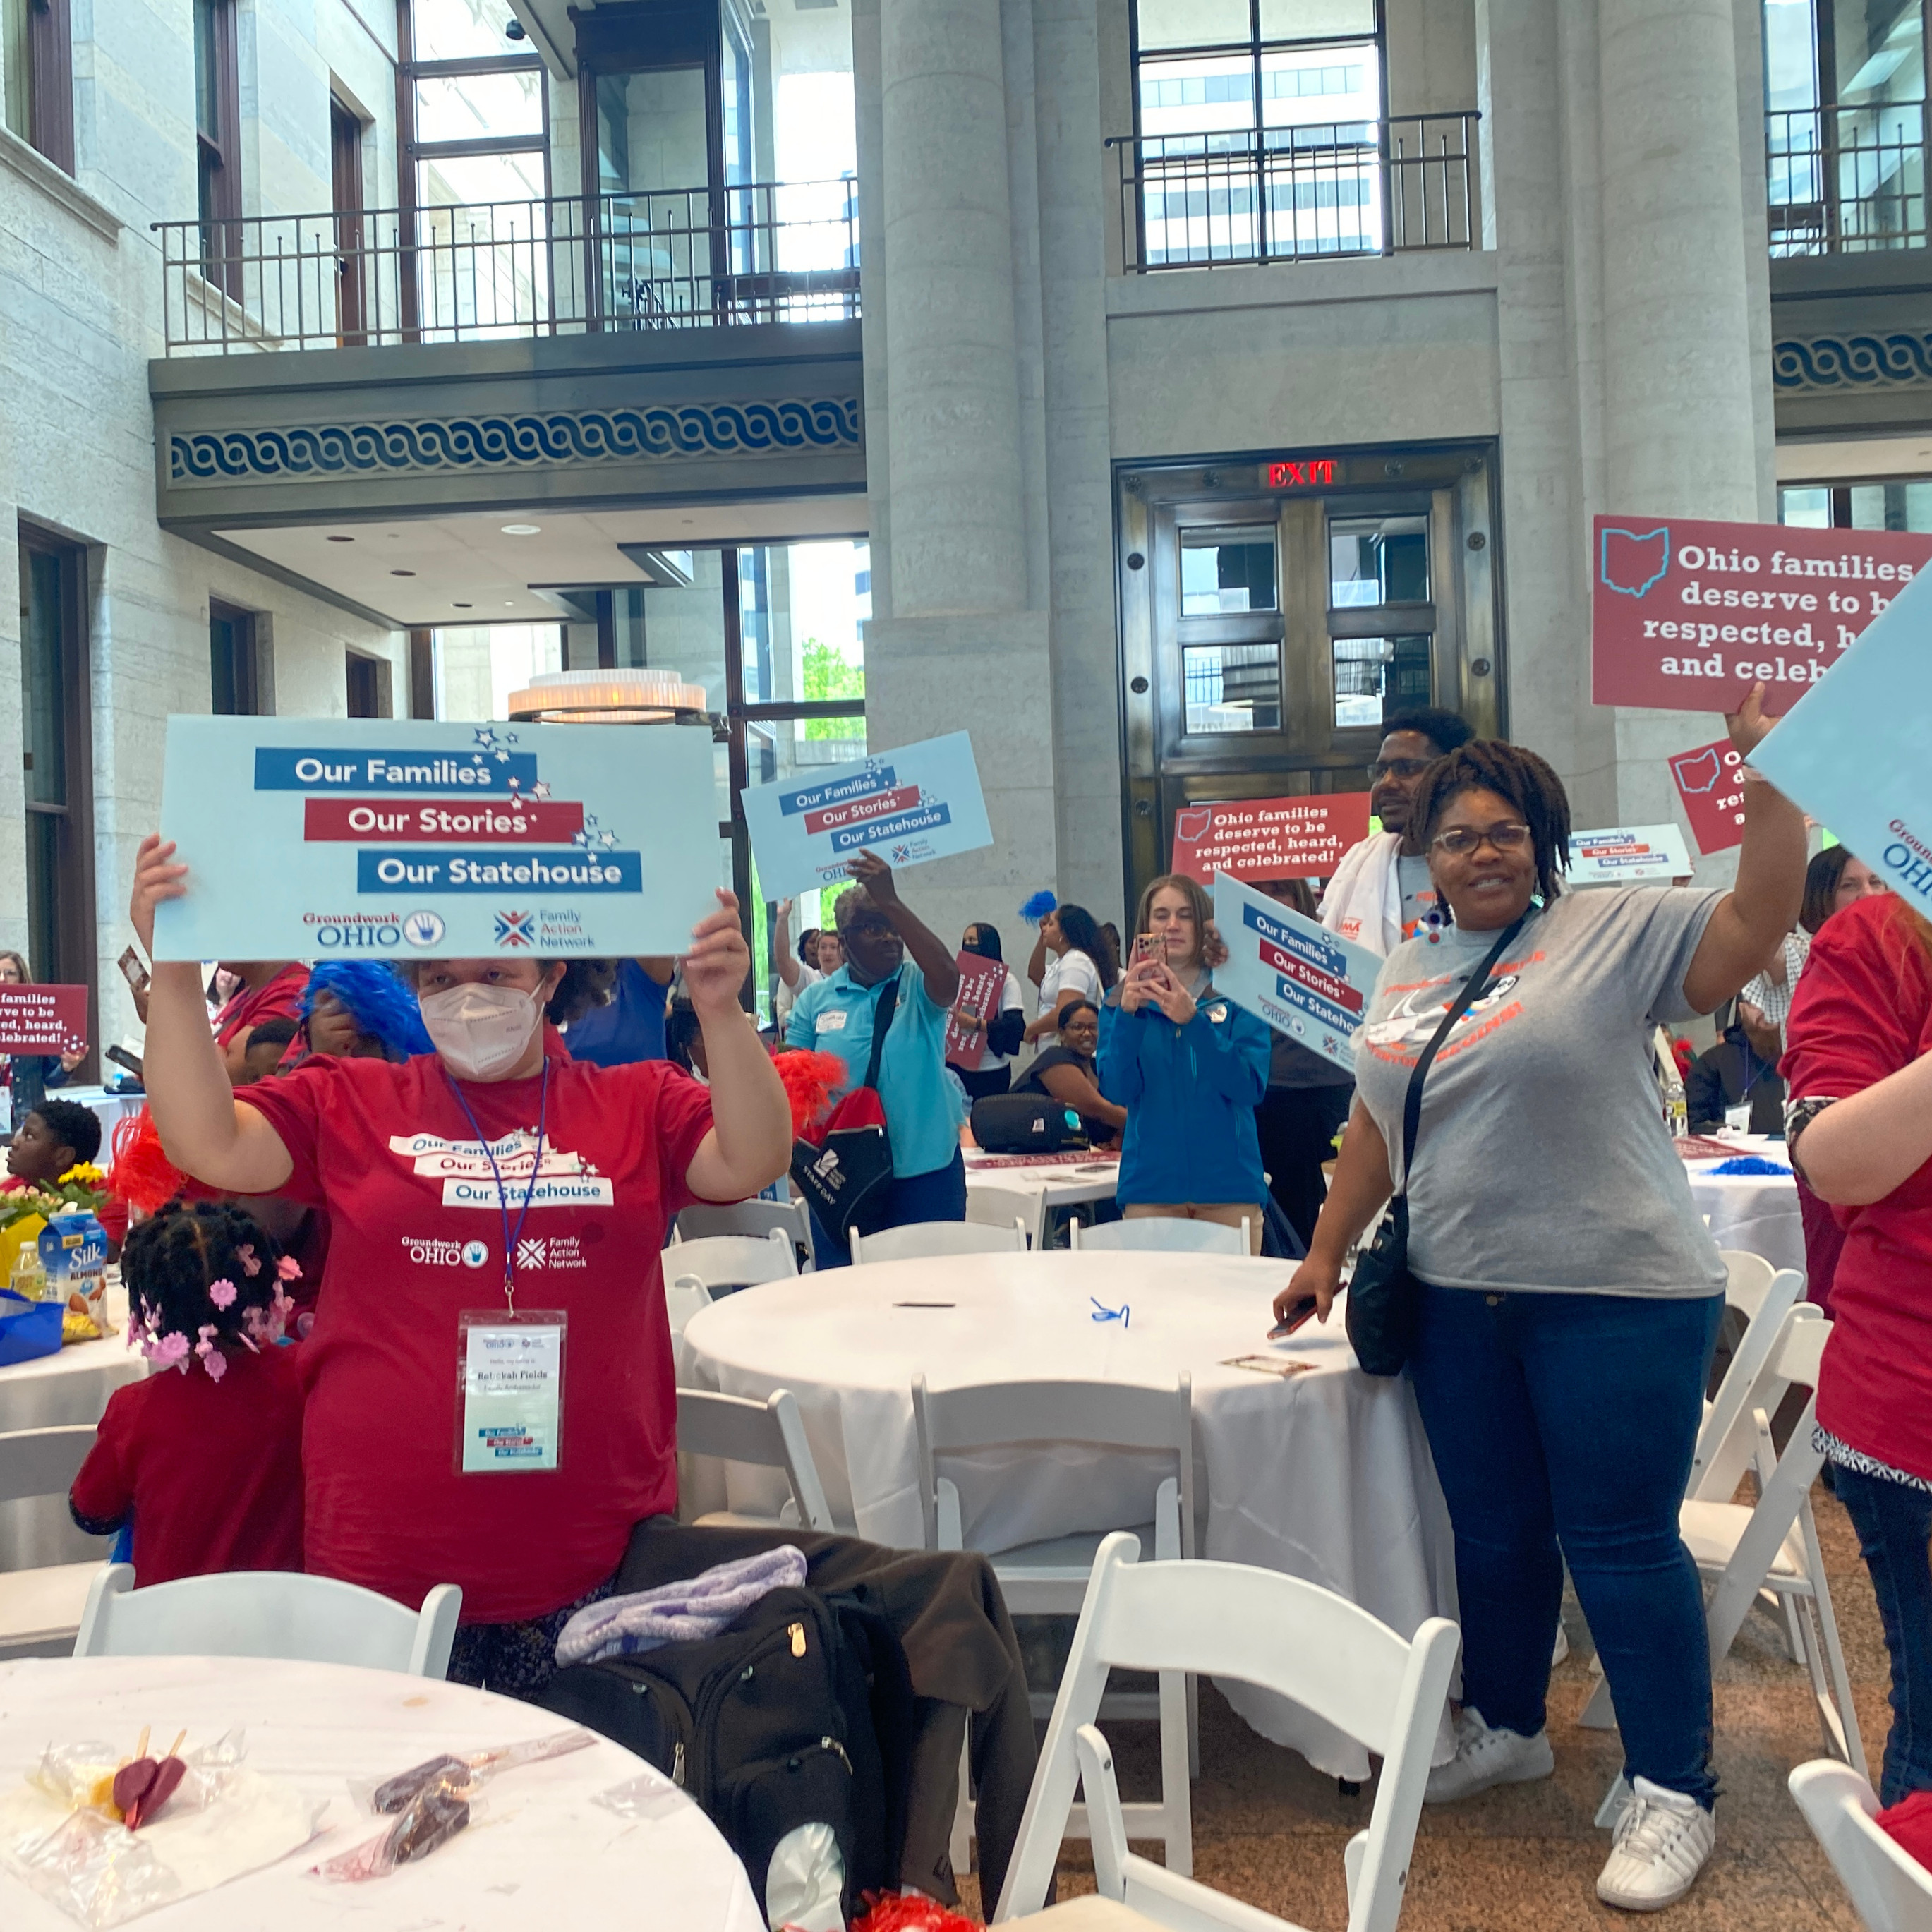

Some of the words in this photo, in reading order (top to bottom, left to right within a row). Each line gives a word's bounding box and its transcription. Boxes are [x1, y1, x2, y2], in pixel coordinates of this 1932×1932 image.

[1269, 460, 1338, 488] EXIT
[1678, 545, 1761, 574] Ohio
[1770, 550, 1914, 581] families
[1681, 581, 1818, 612] deserve
[1828, 591, 1860, 615] to
[1870, 591, 1891, 615] b
[1643, 618, 1825, 652] respected,
[1660, 653, 1725, 678] and
[295, 757, 357, 783] Our
[368, 759, 493, 785] Families
[796, 792, 821, 807] Our
[824, 777, 878, 801] Families
[348, 807, 410, 833] Our
[419, 807, 528, 833] Stories
[822, 811, 848, 826] Our
[850, 798, 897, 819] Stories
[1214, 813, 1254, 827] Ohio
[1258, 807, 1328, 822] families
[839, 831, 865, 846] Our
[867, 812, 942, 840] Statehouse
[1214, 826, 1280, 841] deserve
[1285, 823, 1300, 834] to
[1305, 821, 1326, 833] be
[1195, 839, 1282, 858] respected,
[1288, 835, 1344, 850] heard,
[1889, 819, 1932, 863] Groun
[377, 857, 439, 883] Our
[449, 857, 622, 884] Statehouse
[1202, 857, 1233, 872] and
[1237, 850, 1334, 869] celebrated!
[823, 866, 846, 881] OHI
[303, 912, 401, 924] Groundwork
[539, 909, 581, 923] Family
[317, 925, 401, 948] OHIO
[541, 925, 582, 935] Action
[1257, 916, 1279, 938] Our
[1281, 929, 1328, 965] Families
[540, 936, 595, 948] Network
[965, 977, 975, 991] be
[1274, 951, 1296, 974] Our
[1298, 965, 1340, 997] Stories
[1, 993, 56, 1004] families
[979, 977, 995, 1019] lebrated!
[23, 1007, 35, 1017] to
[38, 1006, 54, 1017] be
[1262, 1004, 1290, 1027] OHIO
[1283, 984, 1305, 1006] Our
[1308, 992, 1357, 1034] Stateho
[25, 1020, 67, 1032] heard,
[0, 1032, 61, 1043] lebrated!
[413, 1138, 447, 1151] Our
[440, 1158, 476, 1170] Our
[456, 1184, 493, 1200] Our
[498, 1182, 601, 1200] Statehouse
[402, 1236, 462, 1250] Groundwork
[550, 1236, 580, 1248] Family
[69, 1243, 103, 1270] Silk
[410, 1246, 461, 1266] OHIO
[548, 1258, 587, 1269] Network
[550, 1247, 579, 1259] Action
[71, 1268, 103, 1281] ALMOND
